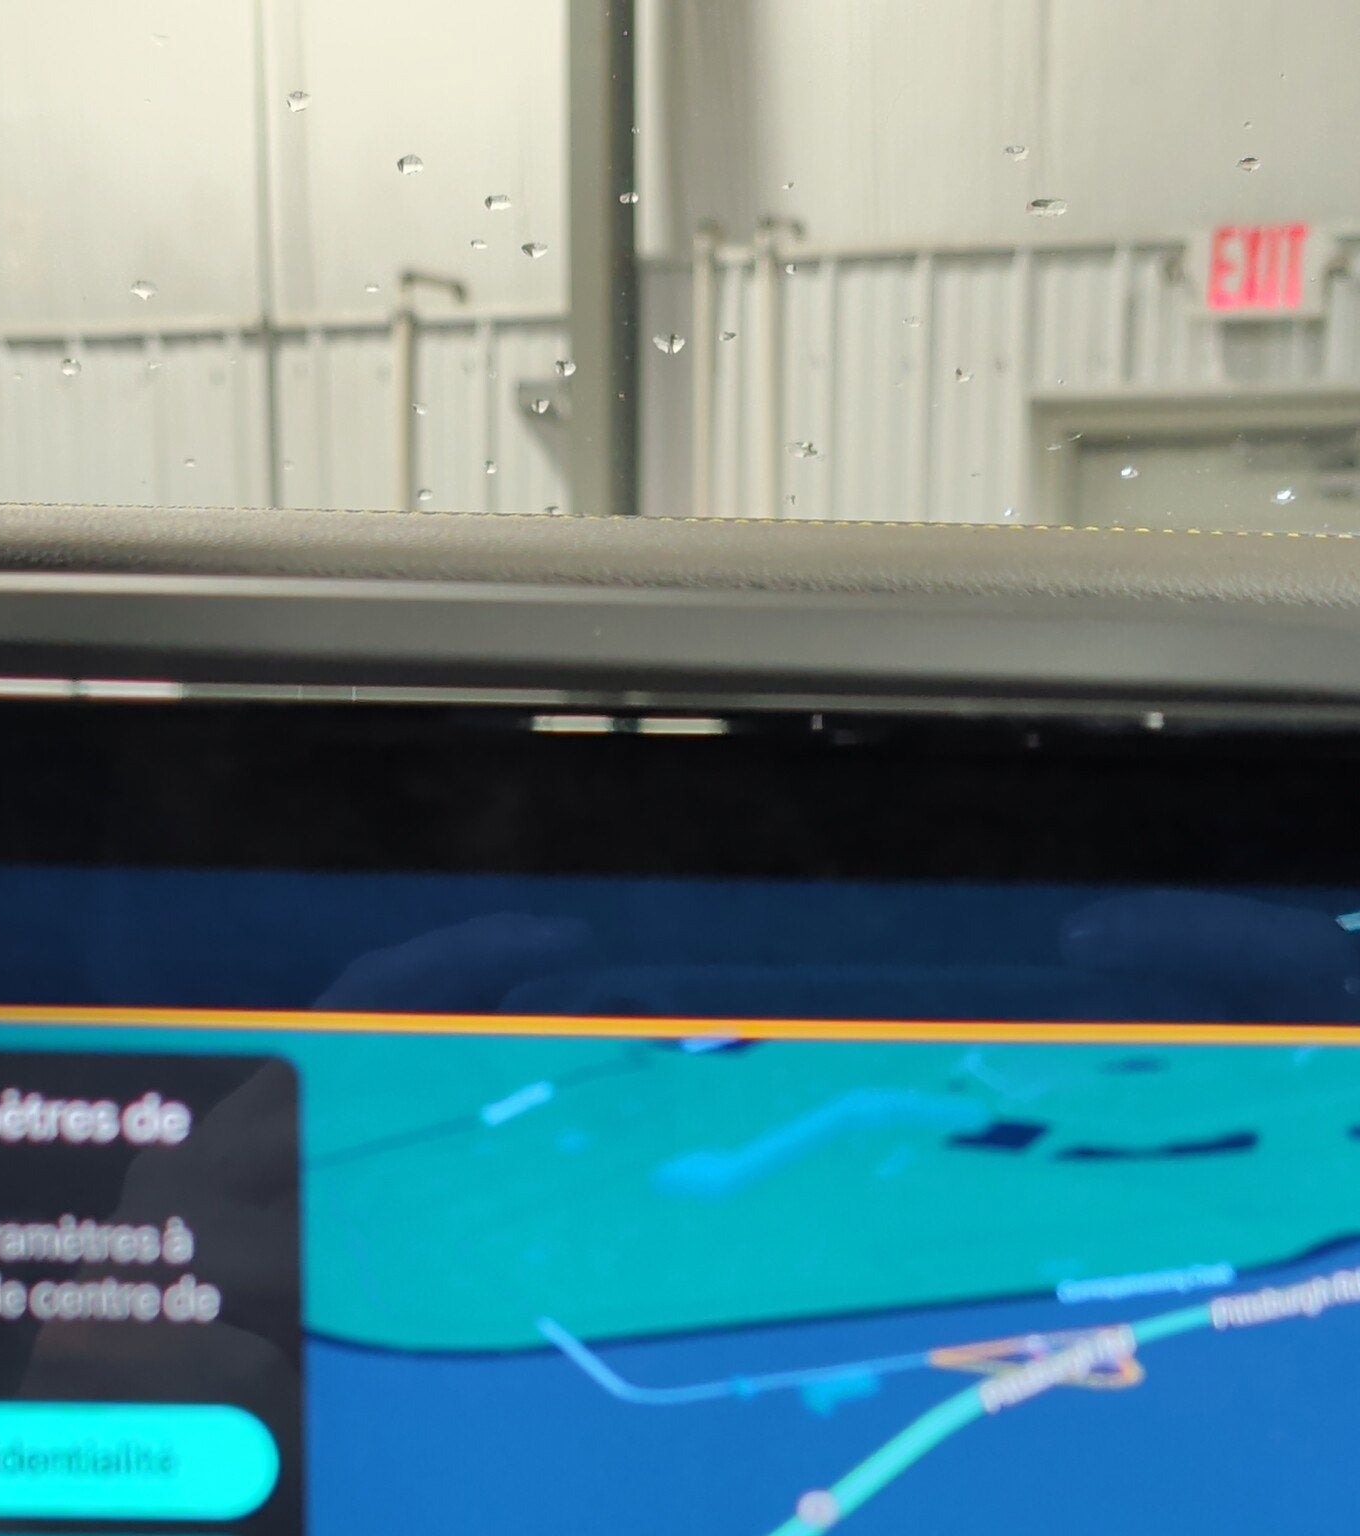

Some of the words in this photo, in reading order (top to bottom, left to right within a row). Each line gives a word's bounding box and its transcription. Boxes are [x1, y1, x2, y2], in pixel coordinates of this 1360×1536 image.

[1208, 223, 1308, 310] EXIT
[122, 1092, 192, 1143] de
[31, 1276, 161, 1322] centre
[163, 1274, 222, 1322] de
